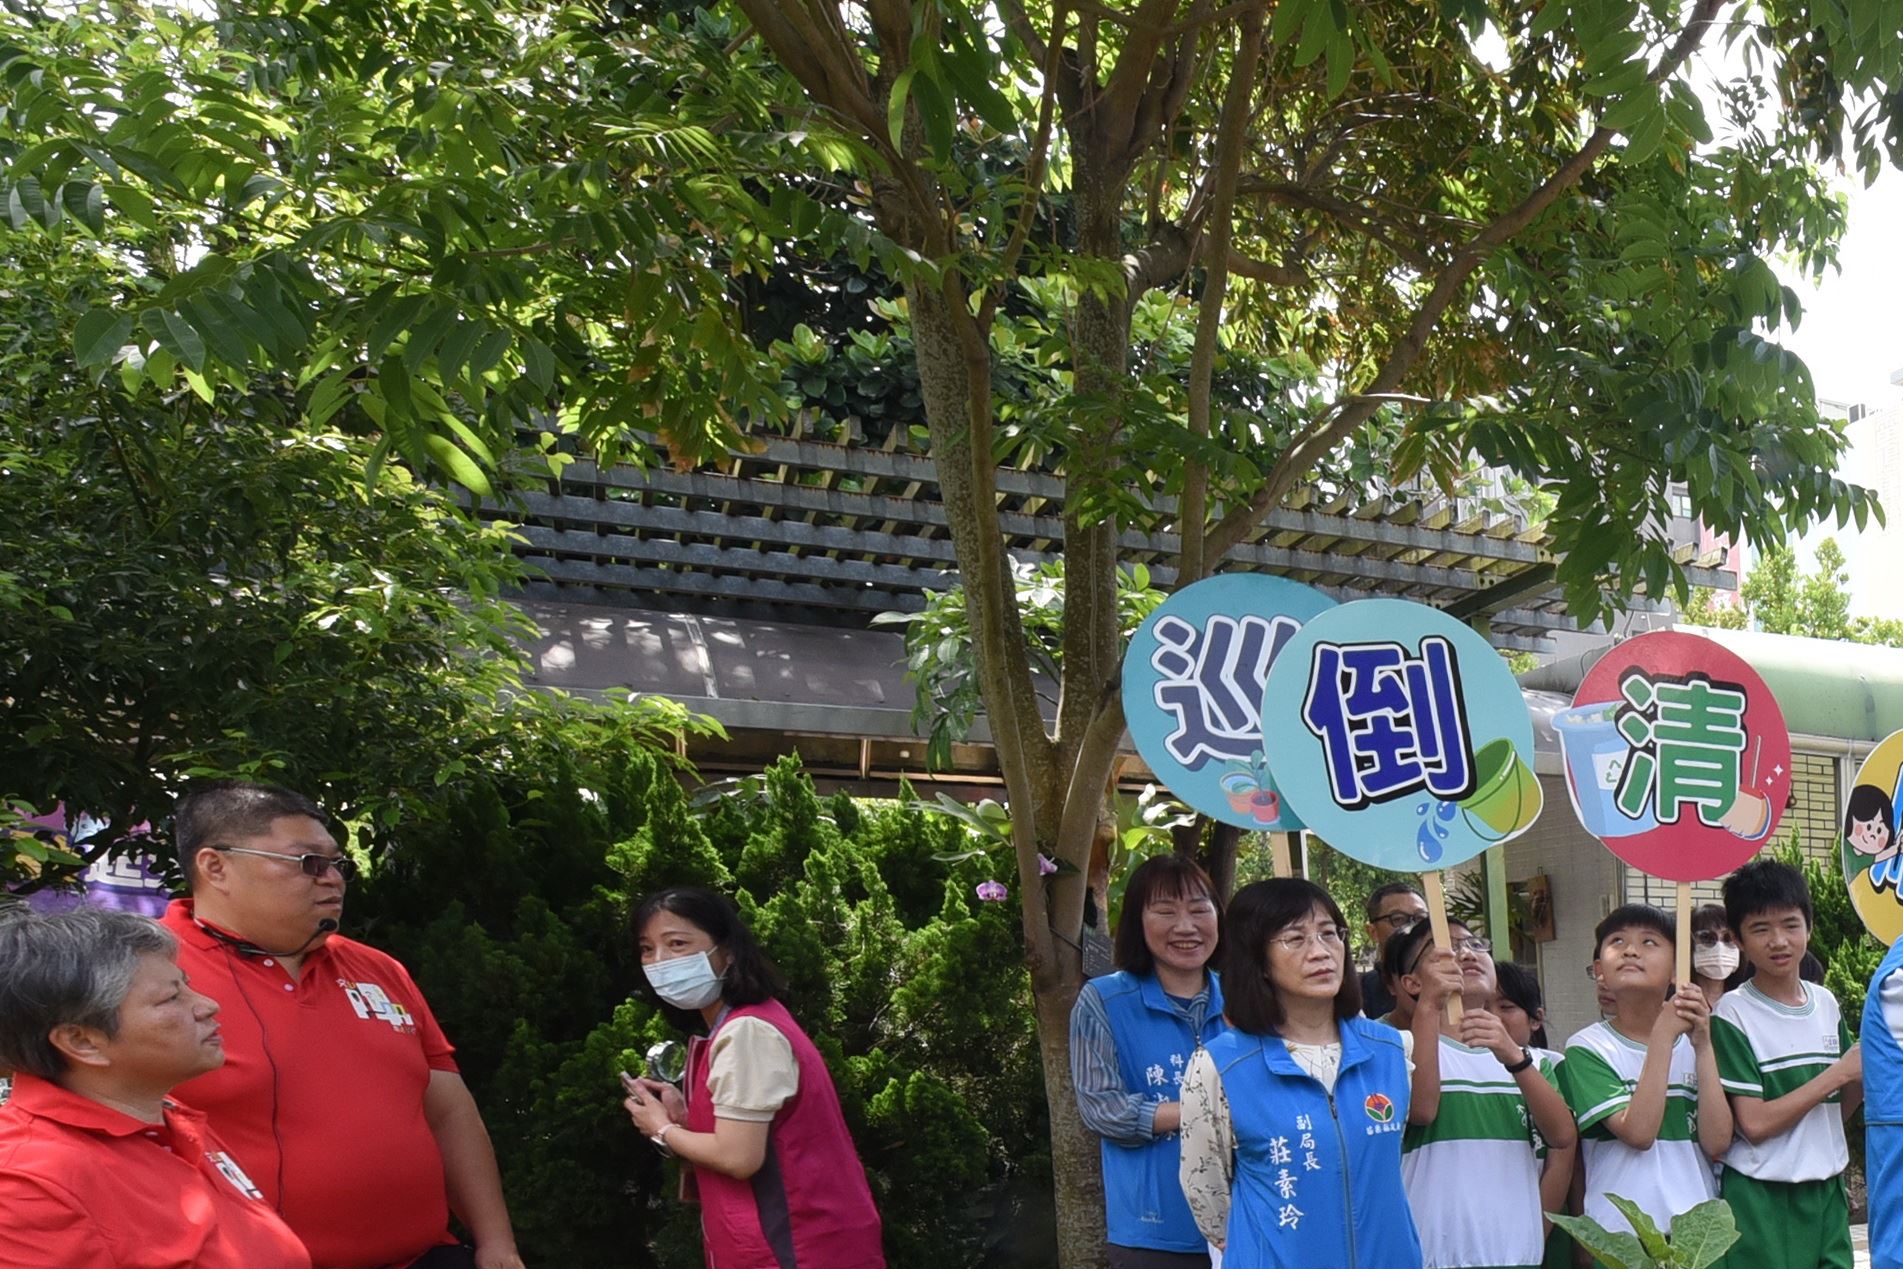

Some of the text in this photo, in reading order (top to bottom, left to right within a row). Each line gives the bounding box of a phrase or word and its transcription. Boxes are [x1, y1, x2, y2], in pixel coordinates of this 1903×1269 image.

[1152, 614, 1300, 767] 巡
[1303, 637, 1477, 810] 倒
[1614, 672, 1749, 824] 清
[1269, 1135, 1304, 1230] 莊素玲
[1296, 1113, 1321, 1171] 副局長
